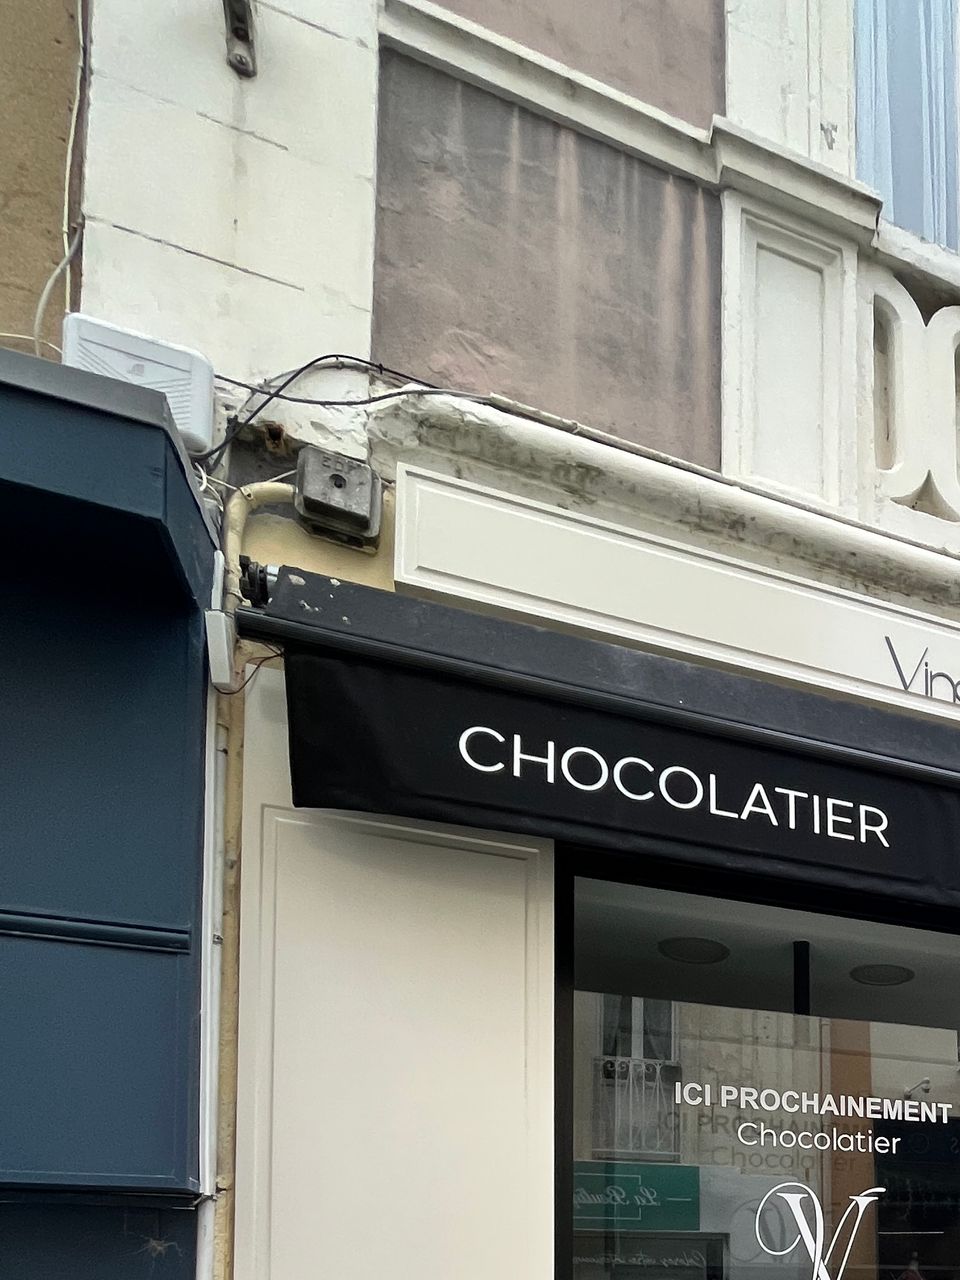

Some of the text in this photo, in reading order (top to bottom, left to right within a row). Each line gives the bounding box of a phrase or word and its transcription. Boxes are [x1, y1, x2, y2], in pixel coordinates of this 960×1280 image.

[457, 725, 891, 848] CHOCOLATIER
[674, 1081, 953, 1124] ICI PROCHAINEMENT
[737, 1122, 902, 1155] Chocolatier
